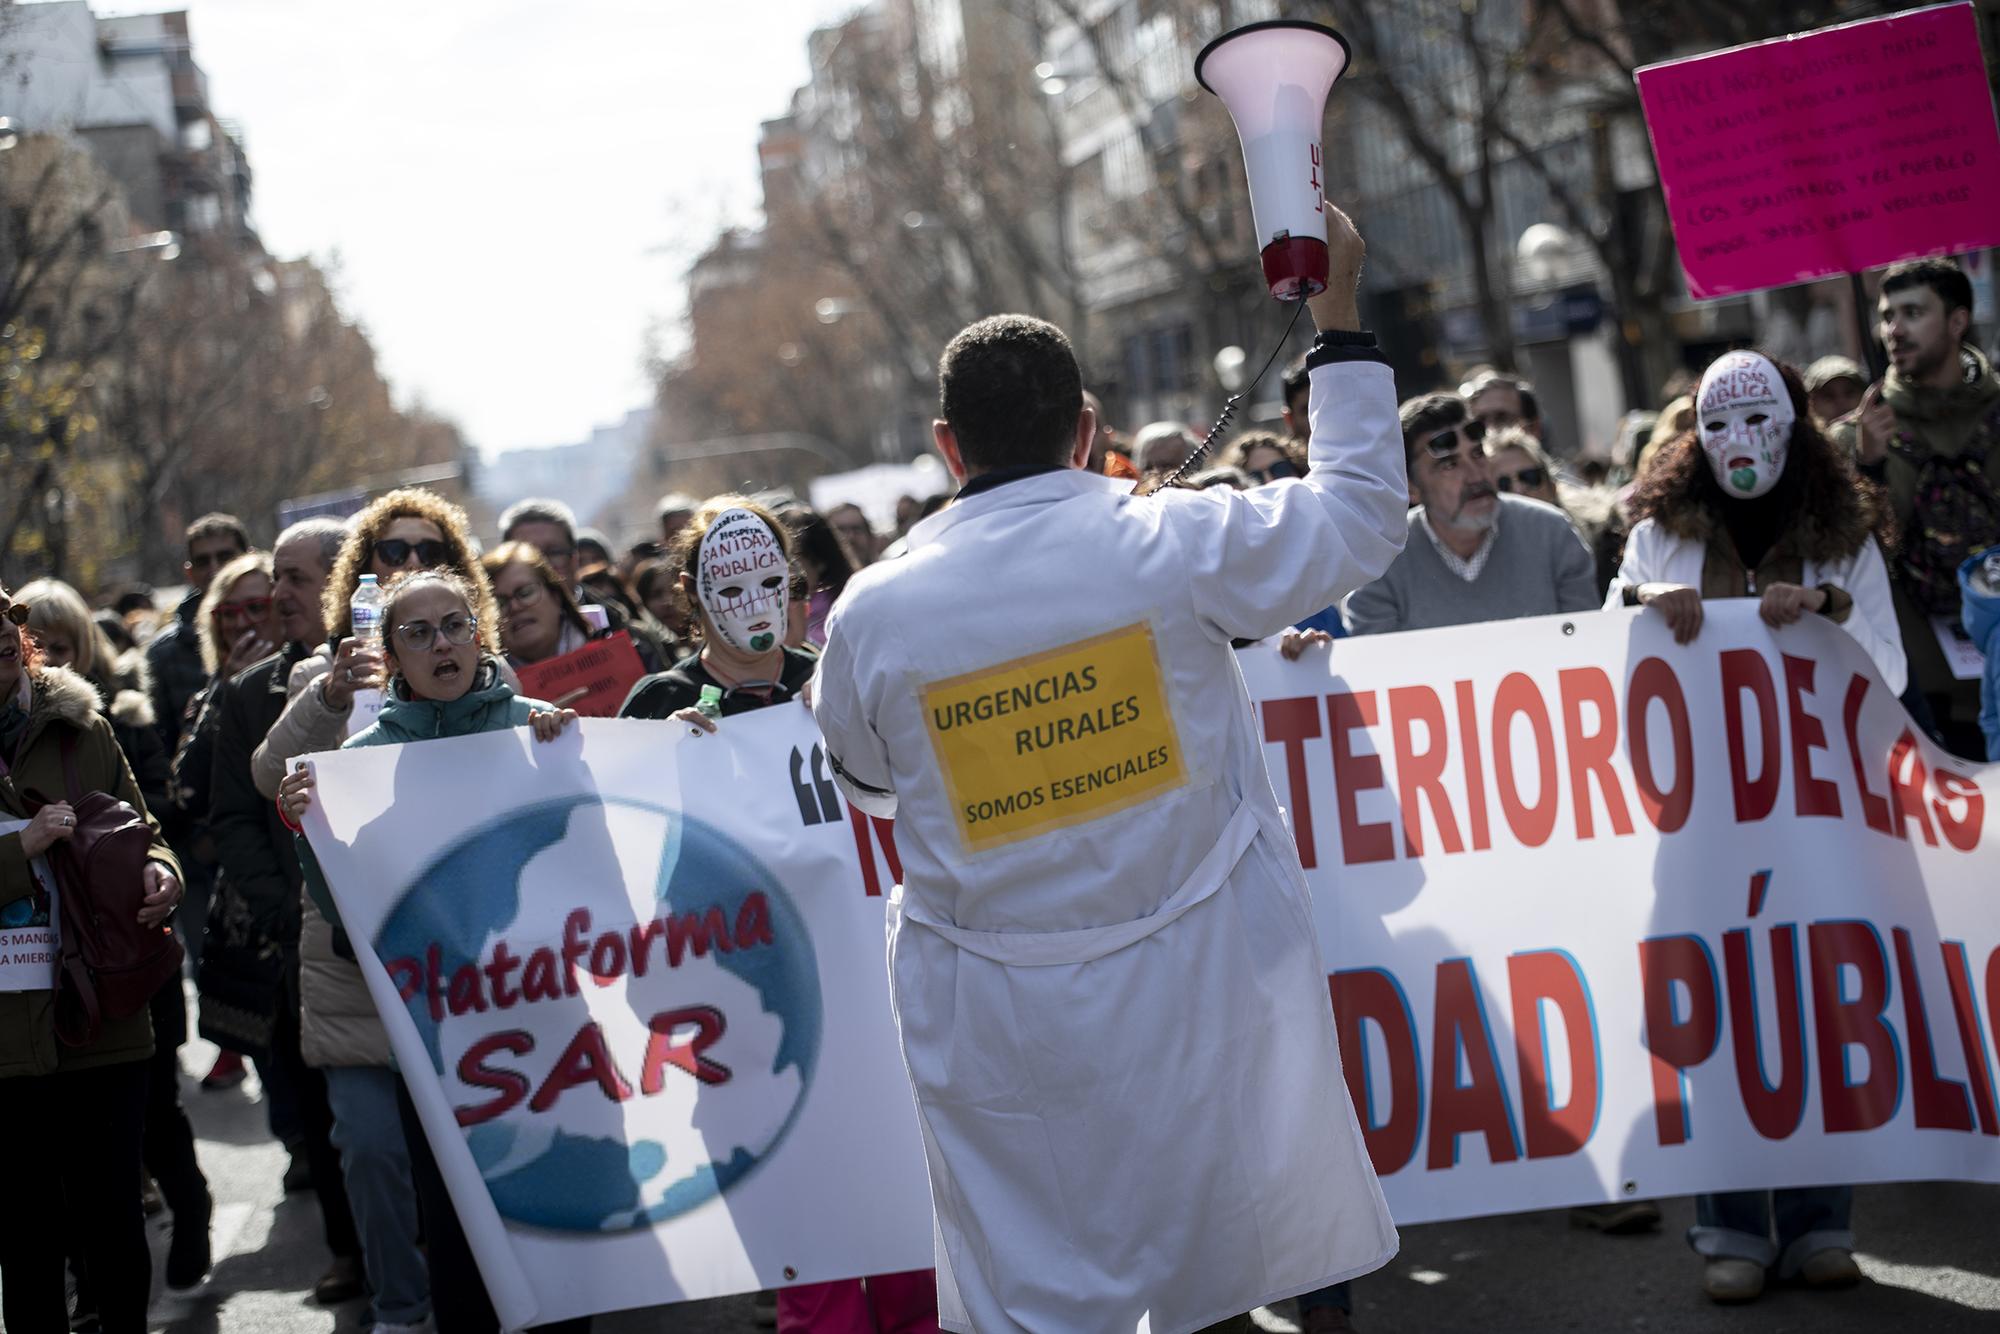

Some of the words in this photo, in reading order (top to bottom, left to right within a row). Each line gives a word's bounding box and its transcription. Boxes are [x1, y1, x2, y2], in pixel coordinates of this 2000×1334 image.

[1686, 203, 1731, 227] LOS
[704, 534, 771, 564] SANIDAD
[933, 665, 1098, 732] URGENCIAS
[1015, 696, 1141, 755] RURALES
[966, 787, 1046, 824] SOMOS
[1050, 745, 1170, 802] ESENCIALES
[1252, 655, 1695, 870] TERIORO
[1718, 648, 1844, 825] DE
[1844, 671, 1985, 854] LAS
[14, 952, 55, 965] MIERD
[385, 891, 774, 1023] Plataforma
[1638, 868, 2000, 1145] PÚBLI
[453, 1004, 734, 1128] SAR
